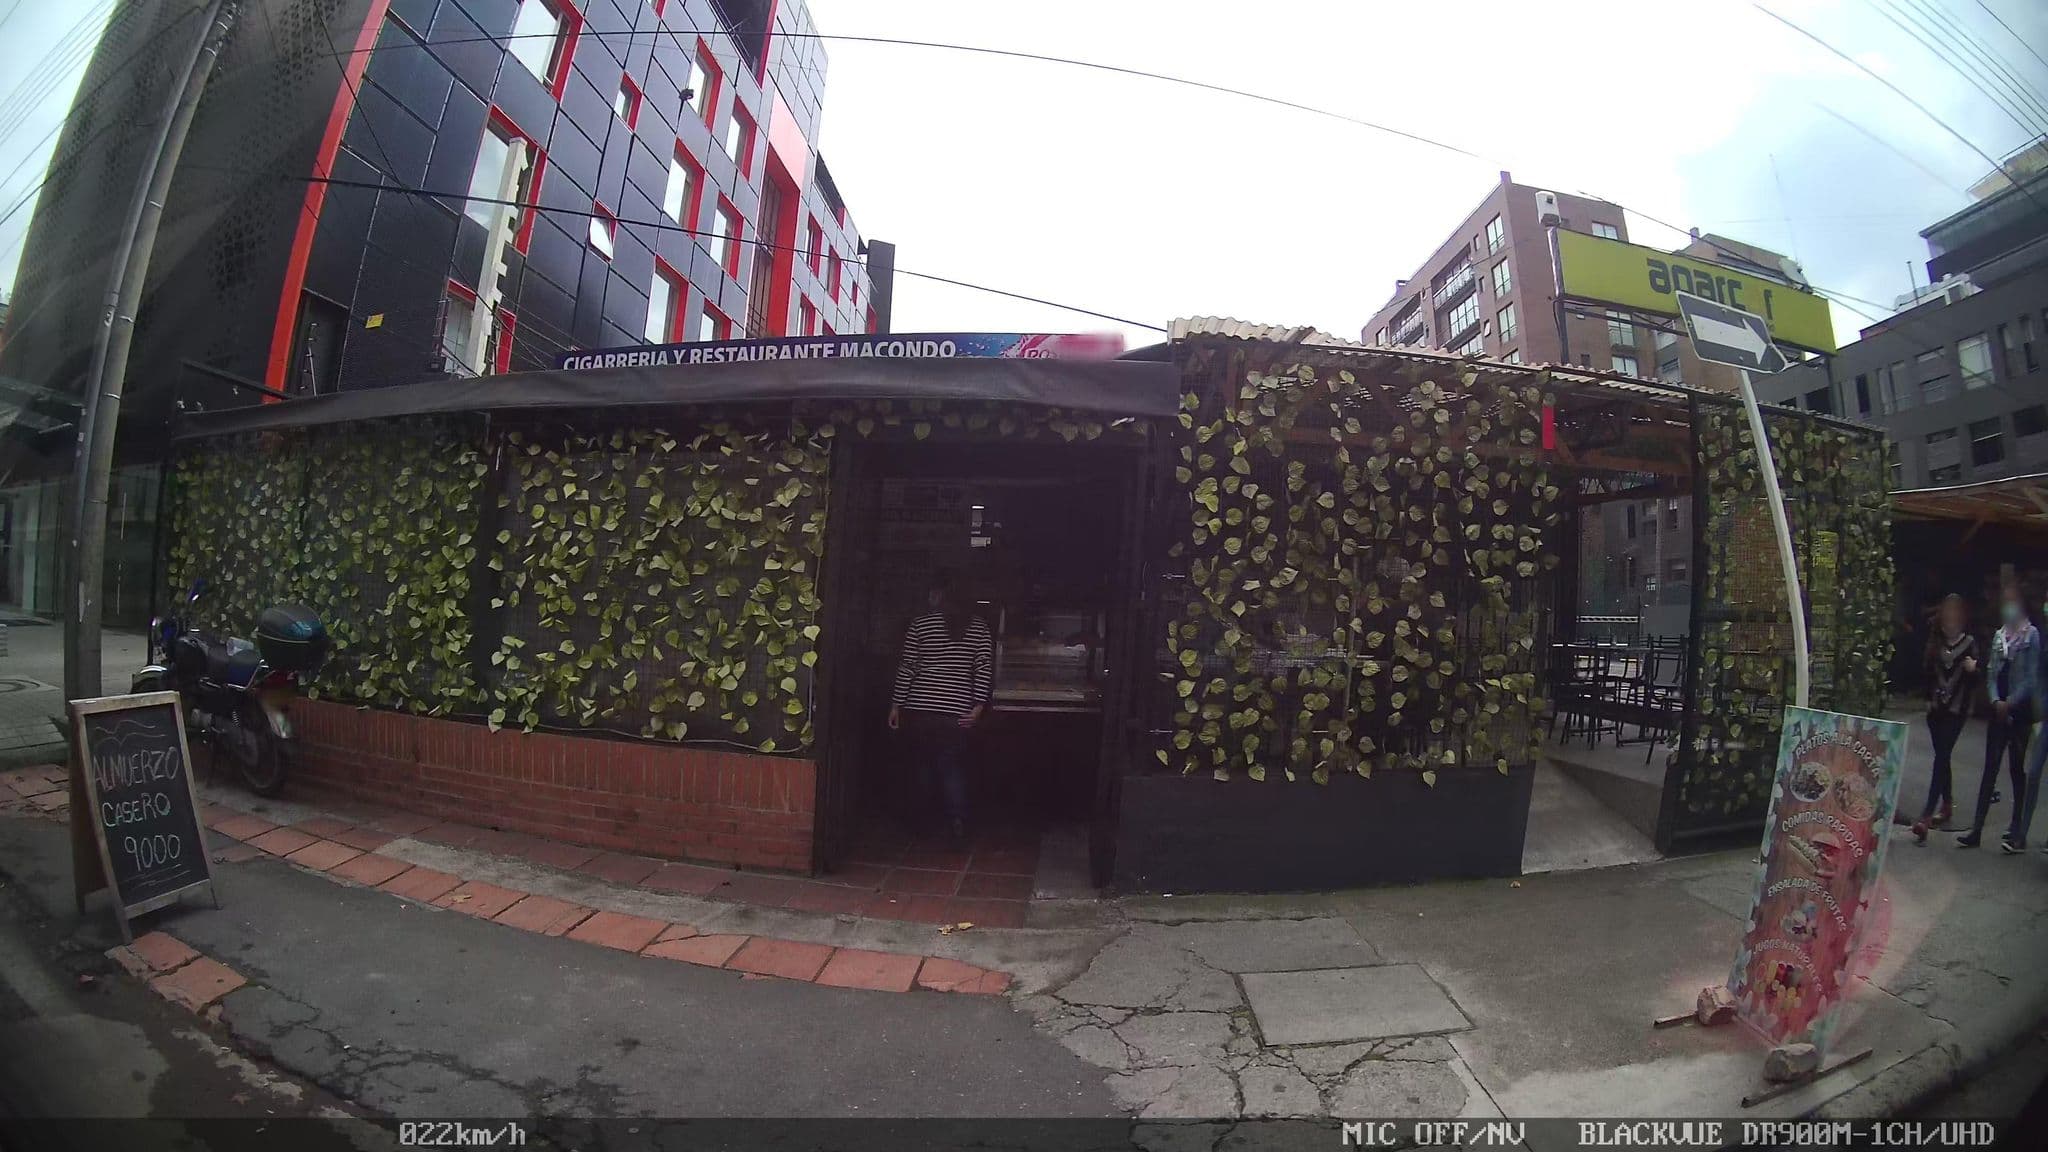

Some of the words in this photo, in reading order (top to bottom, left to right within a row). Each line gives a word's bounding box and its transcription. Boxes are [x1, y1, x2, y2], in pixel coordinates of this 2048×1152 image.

[563, 351, 668, 371] CIGARRERIA
[673, 349, 686, 365] Y
[690, 342, 835, 364] RESTAURANTE
[839, 340, 956, 358] MACONDO
[92, 747, 180, 791] ALMUERZO
[1795, 732, 1829, 759] PLATOS
[1840, 734, 1853, 747] LA
[1853, 740, 1881, 778] CARTA
[102, 793, 171, 827] CASERO
[124, 834, 181, 872] 9000
[1782, 810, 1824, 832] COMIDAS
[1826, 815, 1863, 858] RAPIDAS
[1767, 878, 1810, 898] ENSALADA
[1810, 882, 1823, 896] DE
